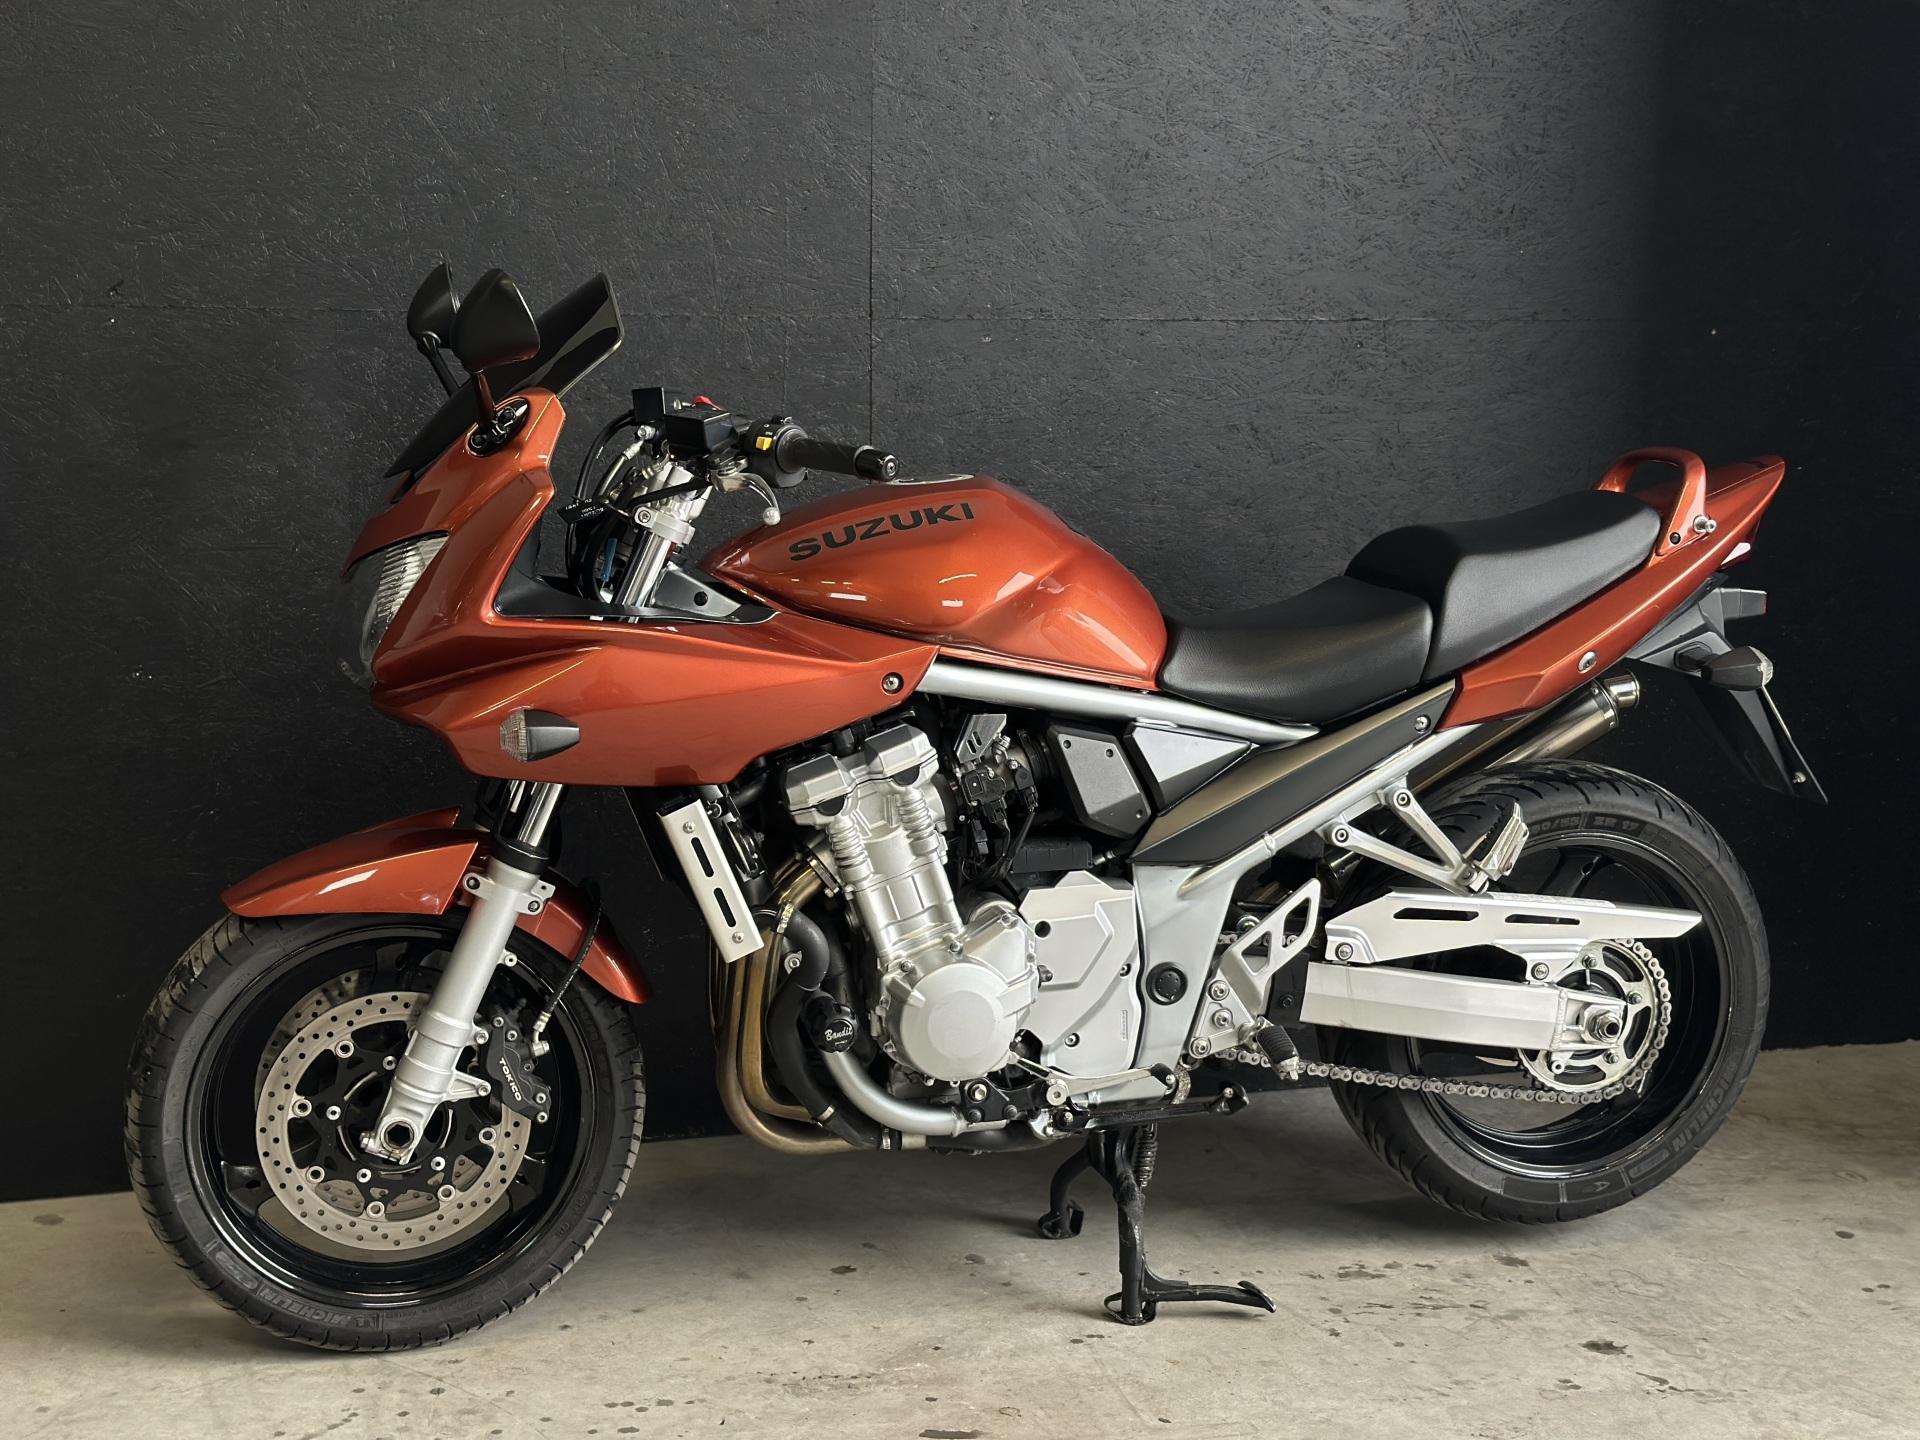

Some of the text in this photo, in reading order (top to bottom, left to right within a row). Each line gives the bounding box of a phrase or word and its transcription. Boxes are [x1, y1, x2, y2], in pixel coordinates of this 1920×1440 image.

[788, 502, 975, 562] SUZUKI
[1530, 816, 1580, 835] 80/55
[824, 1026, 853, 1042] Bandit
[499, 1057, 522, 1101] TOKICO
[1671, 1061, 1738, 1152] MICHELIN
[259, 1287, 351, 1326] MICHELIN
